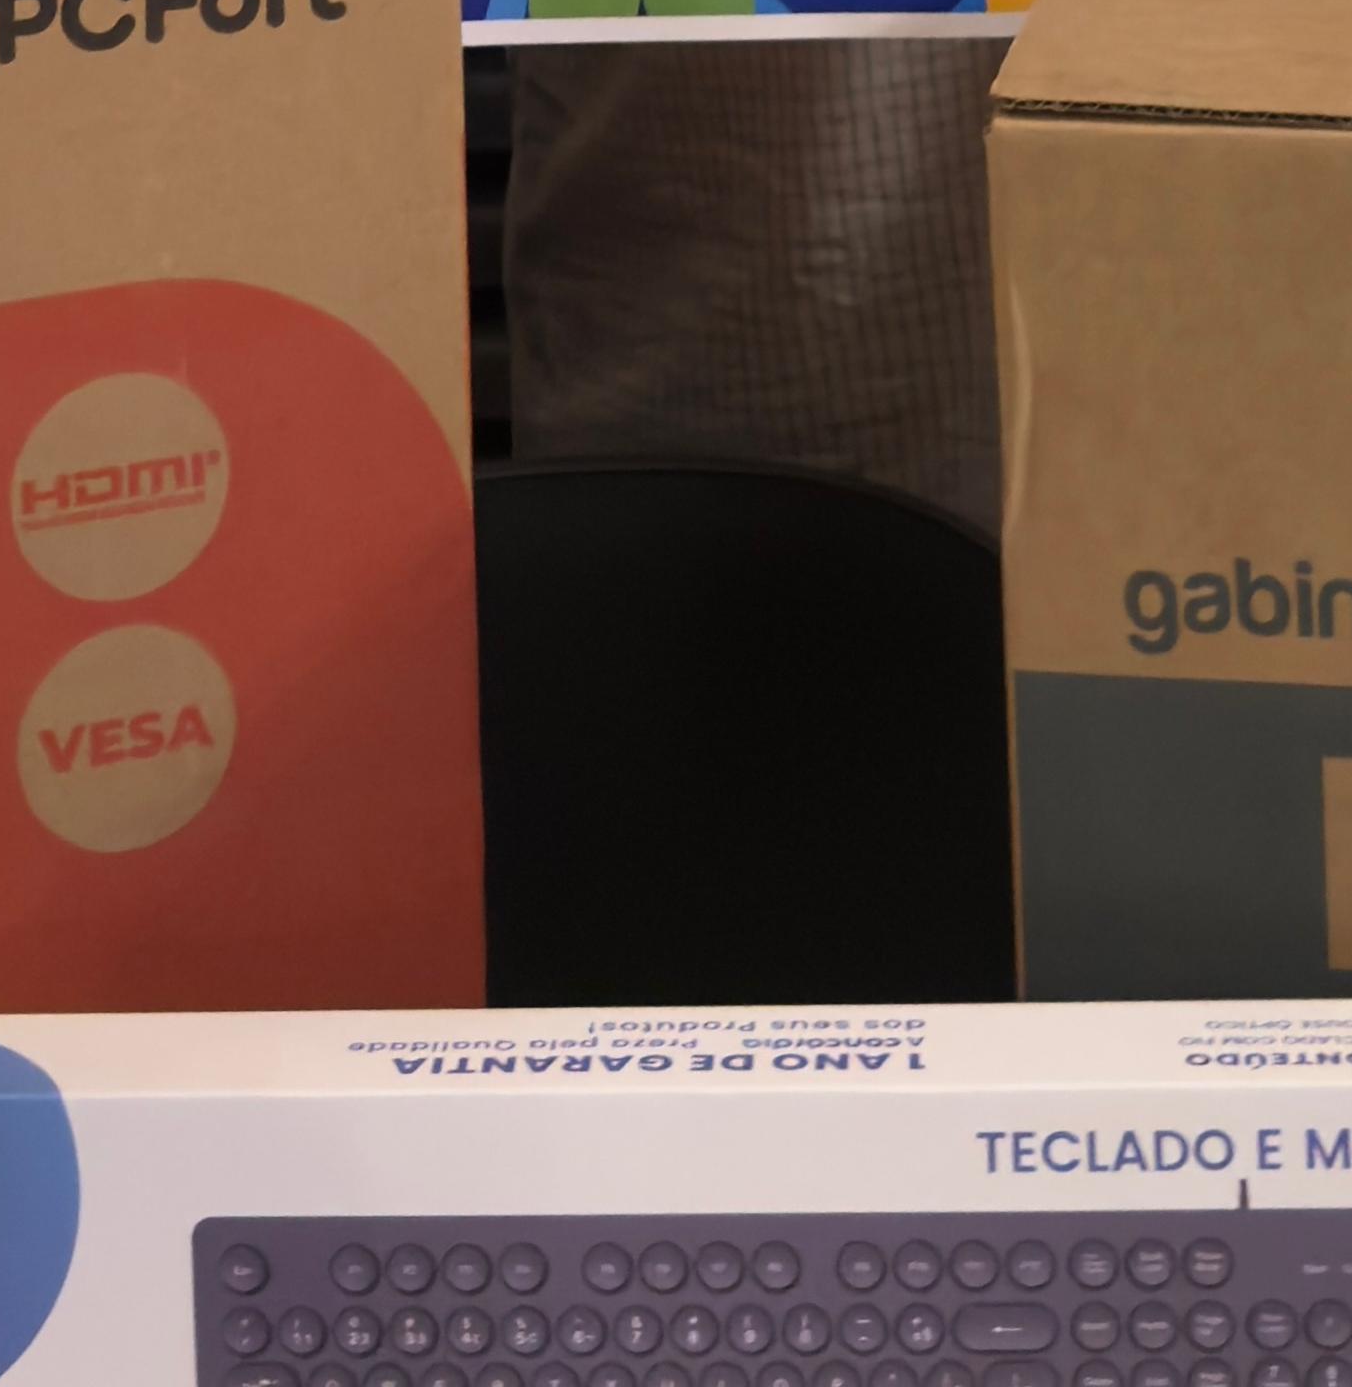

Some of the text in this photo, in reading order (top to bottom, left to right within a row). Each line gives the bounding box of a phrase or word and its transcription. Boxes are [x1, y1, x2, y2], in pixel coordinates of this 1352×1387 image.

[38, 705, 214, 775] VESA
[770, 1019, 850, 1030] seus
[864, 1019, 926, 1030] dos
[348, 1040, 516, 1052] Qualidade
[529, 1037, 599, 1049] pela
[611, 1038, 698, 1049] Preza
[393, 1053, 926, 1074] 1 ANO DE GARANTIA
[976, 1128, 1235, 1174] TECLADO
[1257, 1128, 1283, 1171] E
